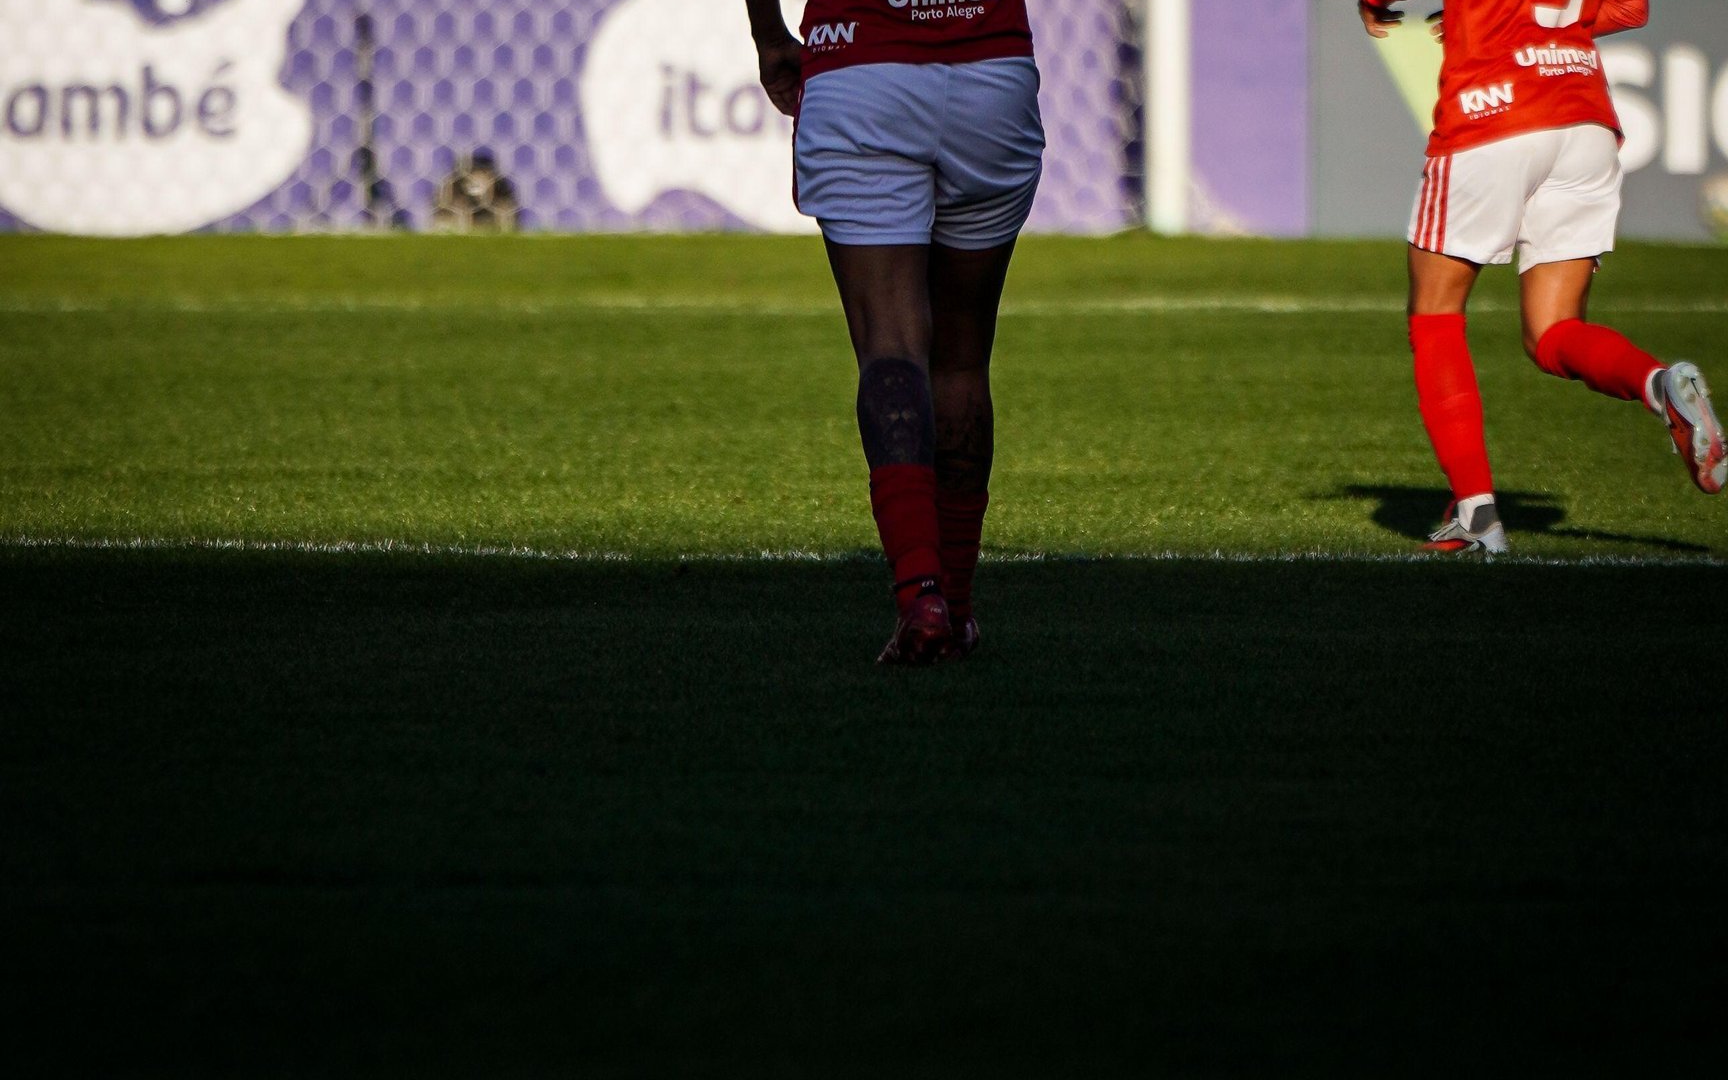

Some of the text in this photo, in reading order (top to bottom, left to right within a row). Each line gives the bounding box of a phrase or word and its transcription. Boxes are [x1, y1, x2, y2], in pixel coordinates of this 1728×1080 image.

[911, 5, 985, 20] Porto Alegre
[807, 21, 856, 47] KNN
[1515, 43, 1598, 69] Unimed
[1539, 66, 1565, 77] Porto
[1459, 83, 1514, 114] KNN
